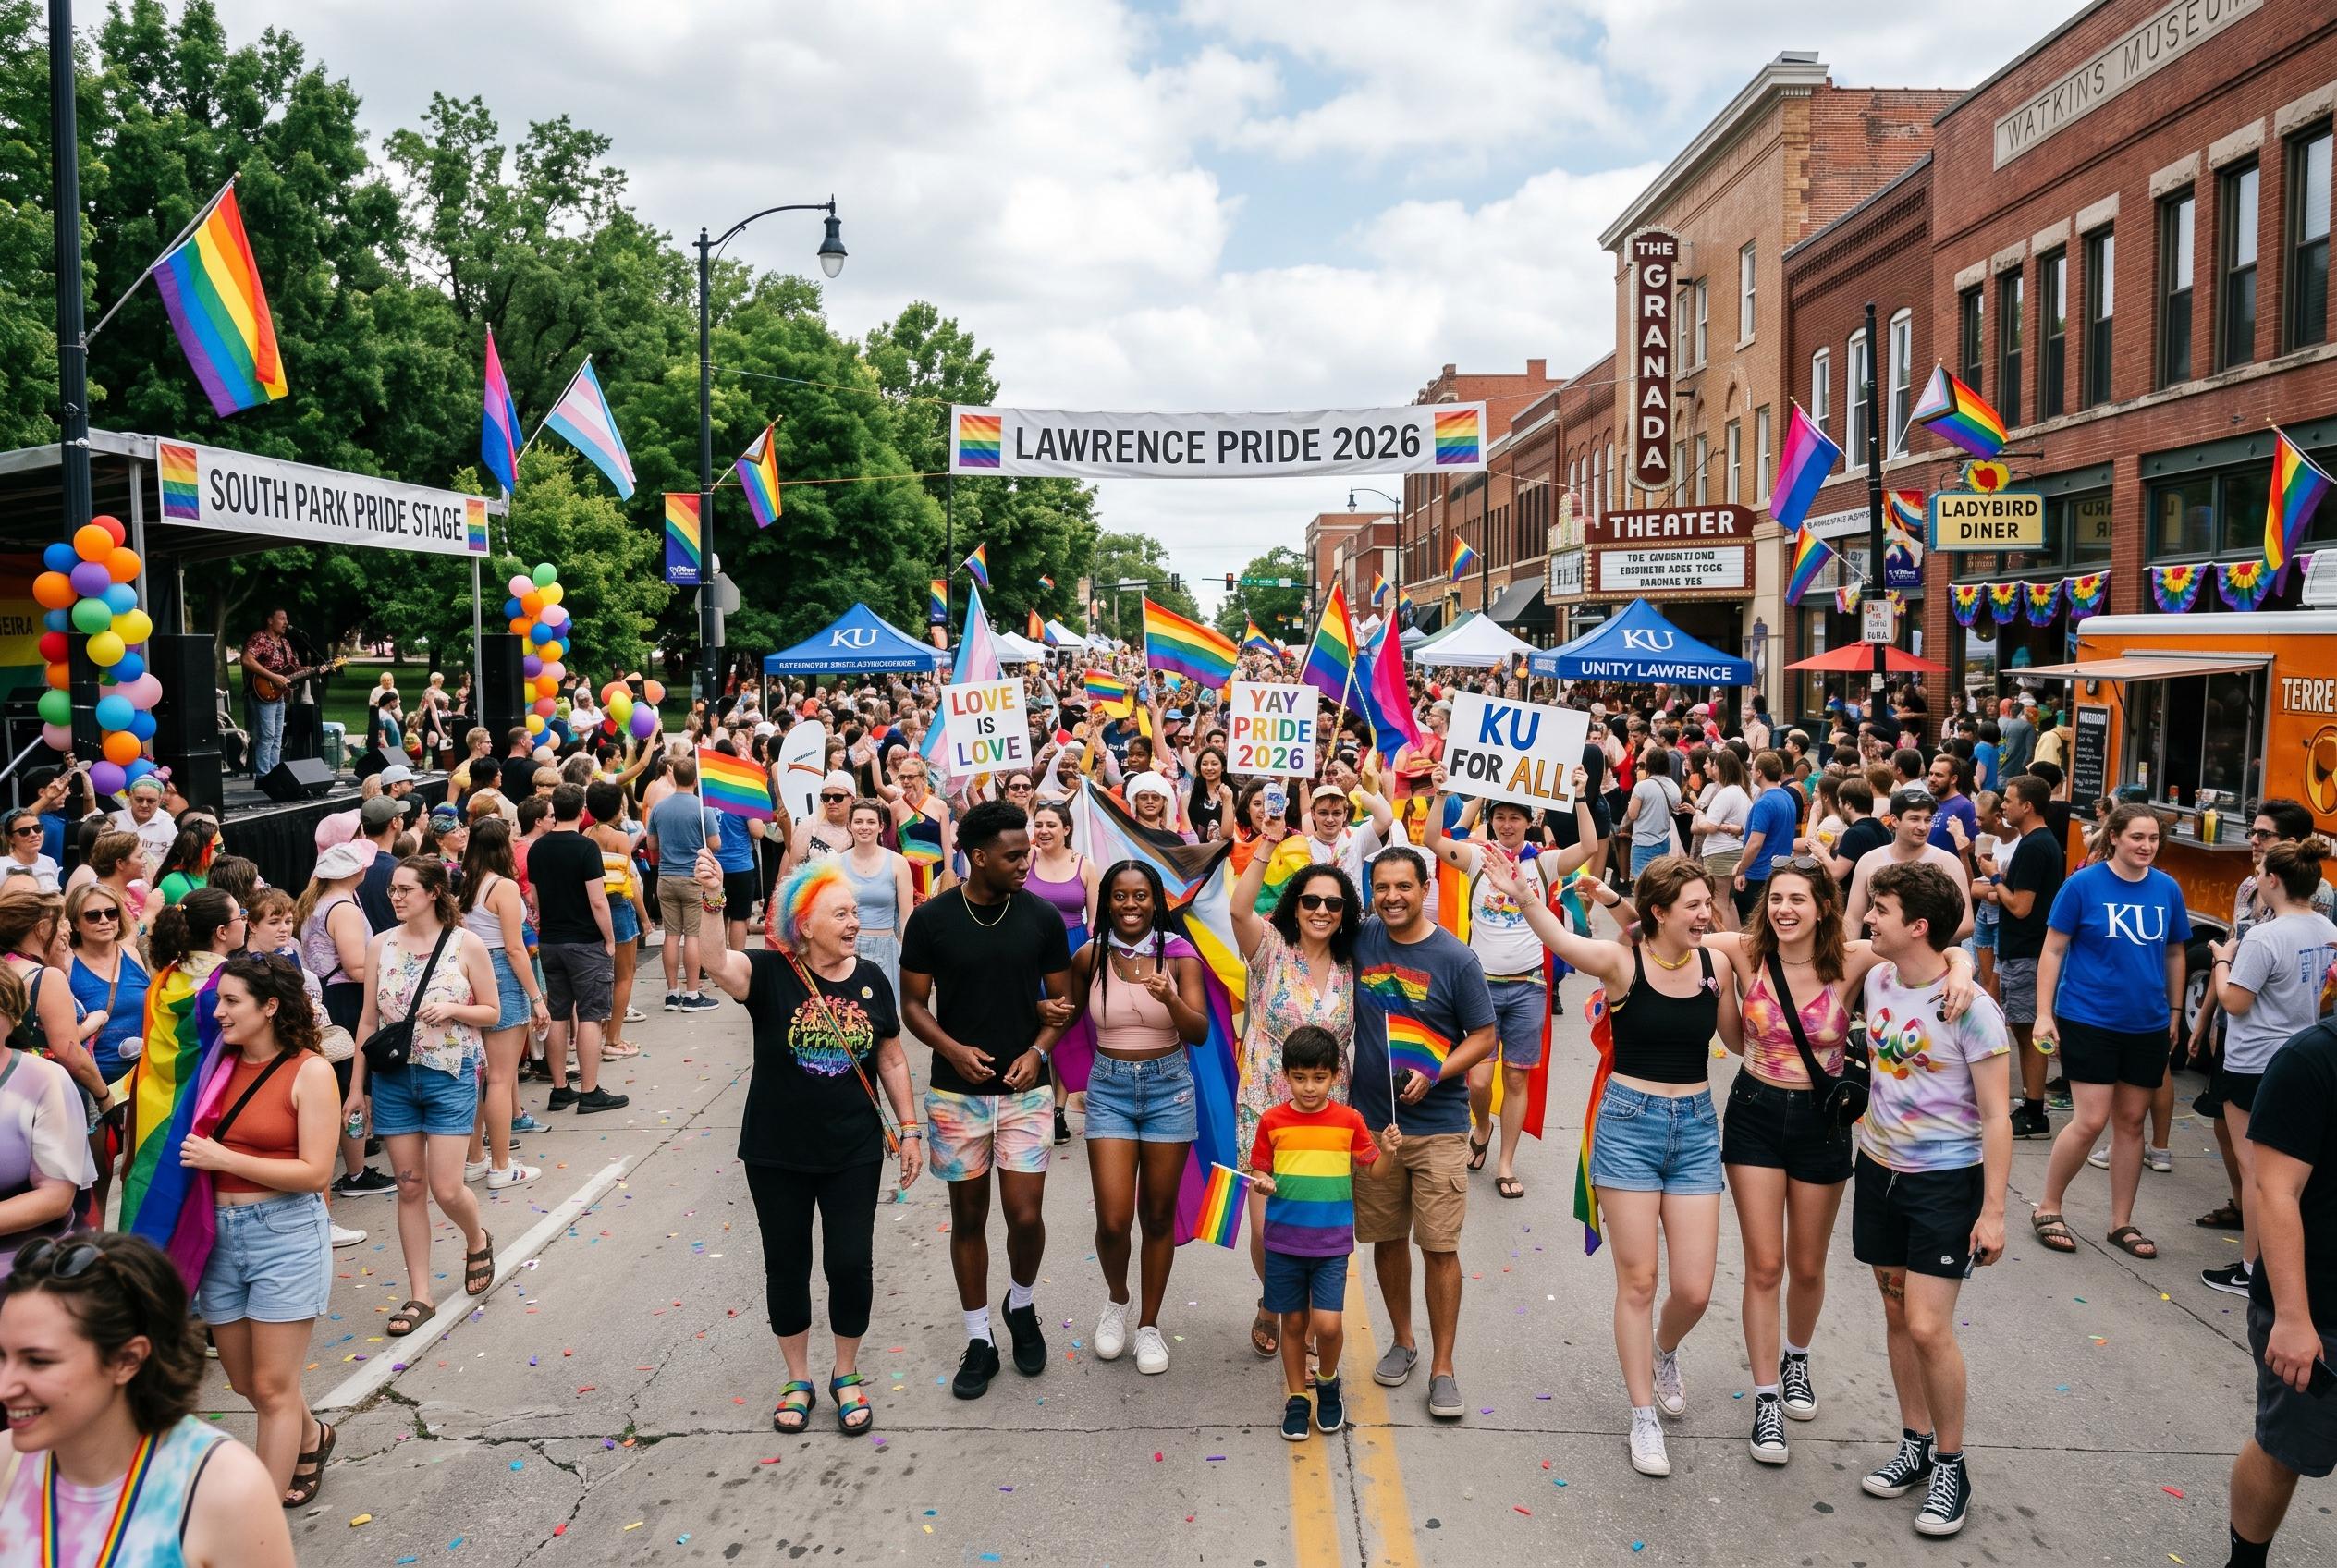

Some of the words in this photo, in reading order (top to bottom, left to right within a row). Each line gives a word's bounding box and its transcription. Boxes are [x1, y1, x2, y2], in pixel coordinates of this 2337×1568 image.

[2007, 62, 2106, 150] WATKINS
[1636, 242, 1674, 256] THE
[1642, 264, 1668, 469] GRANADA
[1016, 426, 1206, 463] LAWRENCE
[1217, 427, 1321, 463] PRIDE
[1332, 423, 1421, 461] 2026
[210, 468, 288, 520] SOUTH
[295, 483, 349, 527] PARK
[354, 492, 408, 534] PRIDE
[412, 502, 462, 541] STAGE
[1942, 500, 2037, 518] LADYBIRD
[1609, 510, 1734, 539] THEATER
[1960, 522, 2019, 539] DINER
[828, 628, 879, 649] KU
[1620, 629, 1674, 653] KU
[1581, 661, 1633, 677] UNITY
[1637, 663, 1732, 680] LAWRENCE
[951, 686, 1015, 716] LOVE
[1250, 689, 1300, 714] YAY
[976, 717, 996, 735] IS
[1234, 717, 1312, 743] PRIDE
[1478, 703, 1541, 751] KU
[957, 735, 1022, 766] LOVE
[1237, 744, 1304, 770] 2026
[1449, 748, 1504, 784] FOR
[1505, 755, 1569, 802] ALL
[2102, 902, 2165, 946] KU
